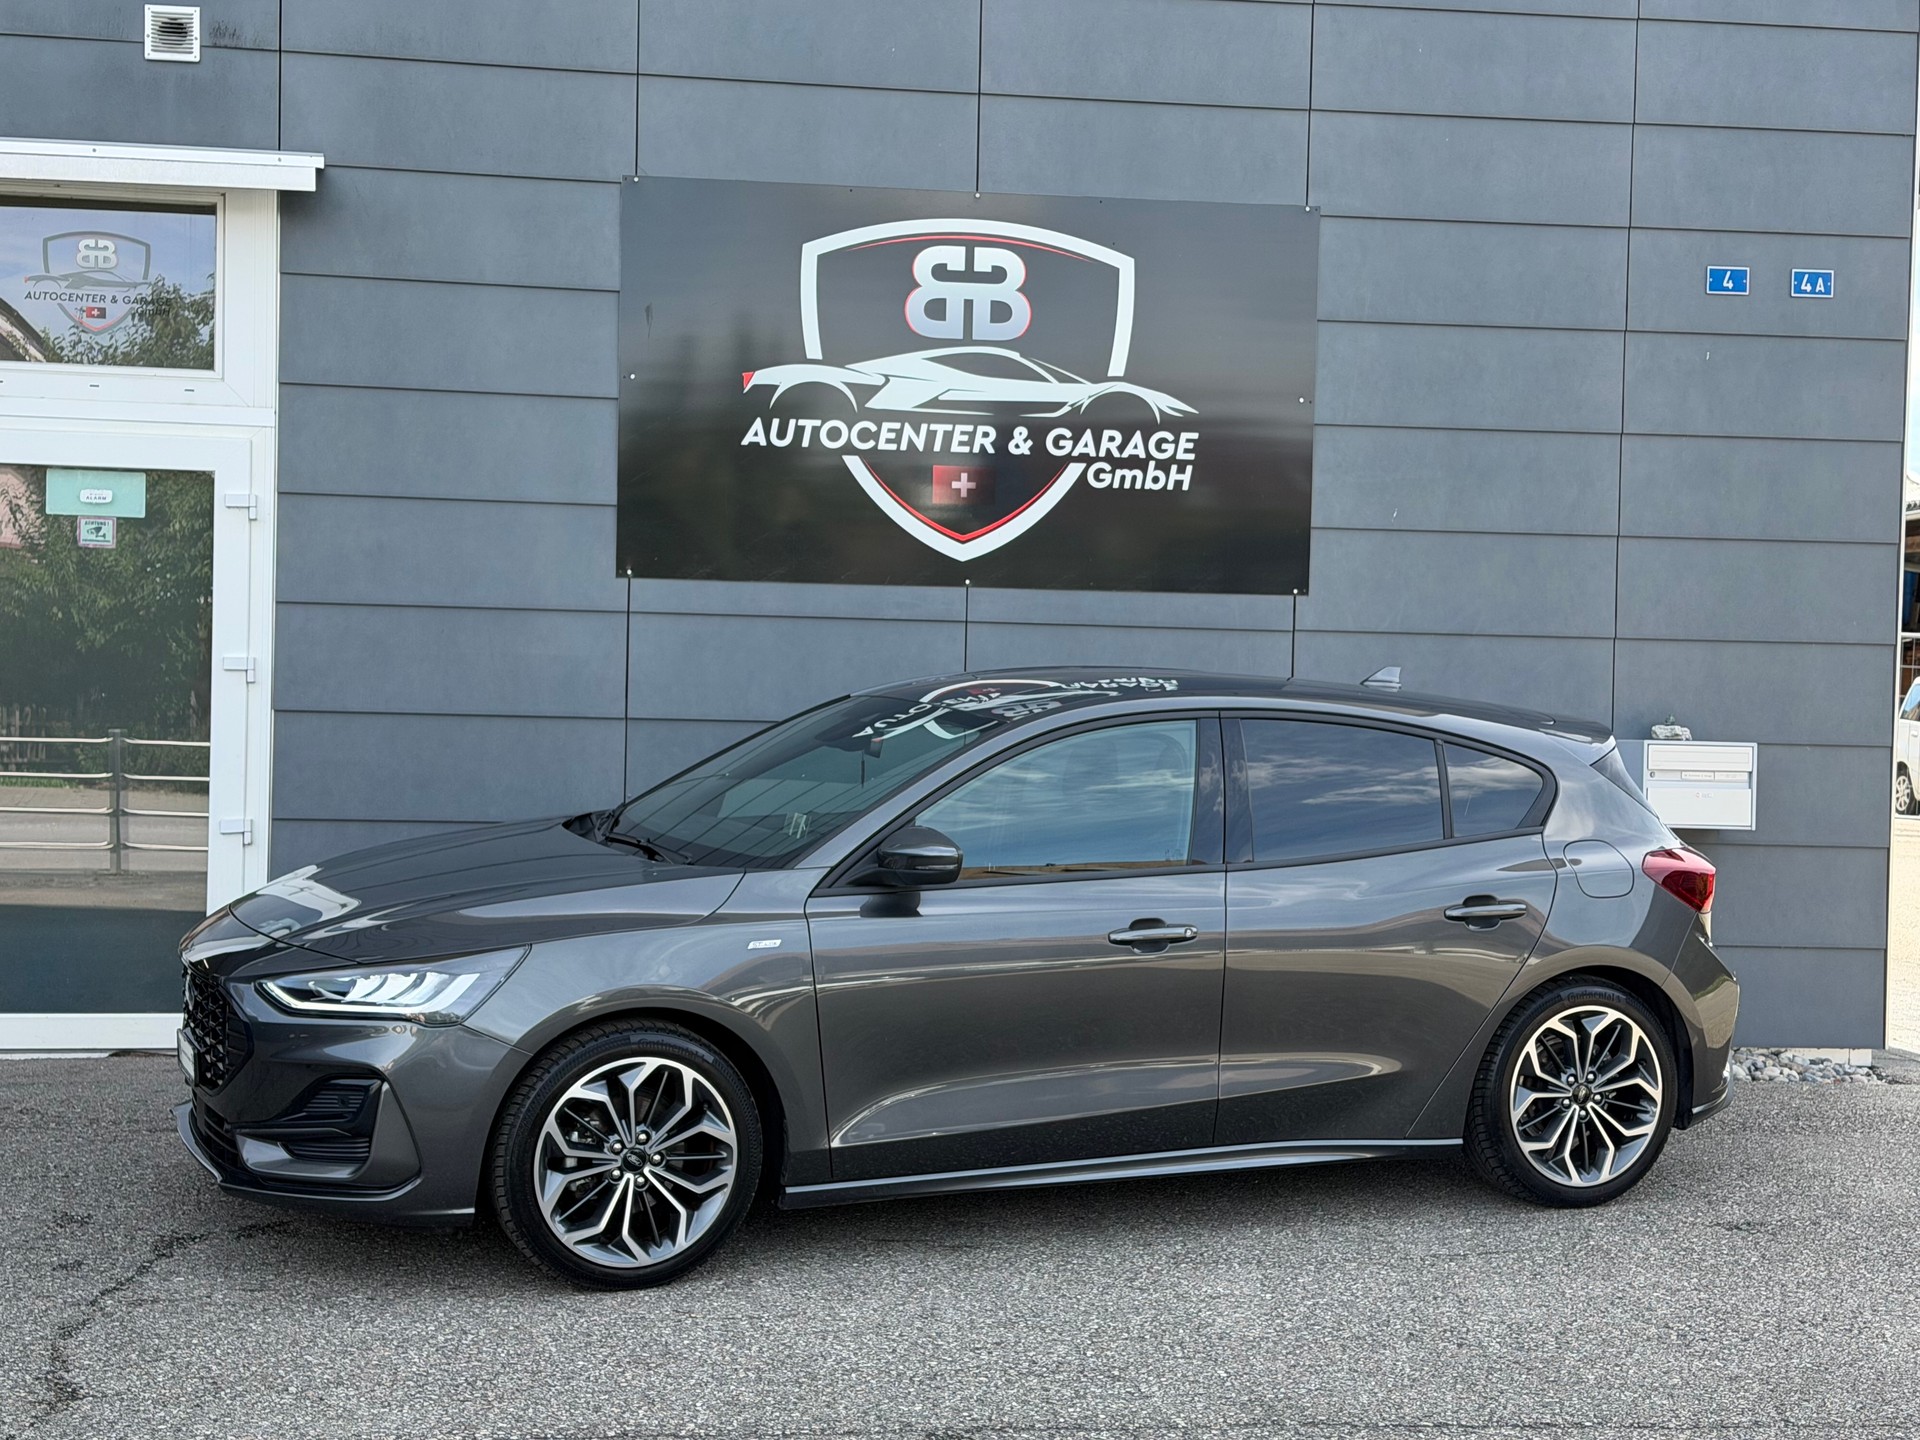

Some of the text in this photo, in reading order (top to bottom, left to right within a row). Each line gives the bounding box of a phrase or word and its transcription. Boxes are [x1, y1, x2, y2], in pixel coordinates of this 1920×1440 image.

[1723, 271, 1734, 289] 4
[24, 291, 171, 307] AUTOCENTER & GARAGE
[741, 417, 1199, 460] AUTOCENTER & GARAGE
[1086, 462, 1193, 491] GmbH
